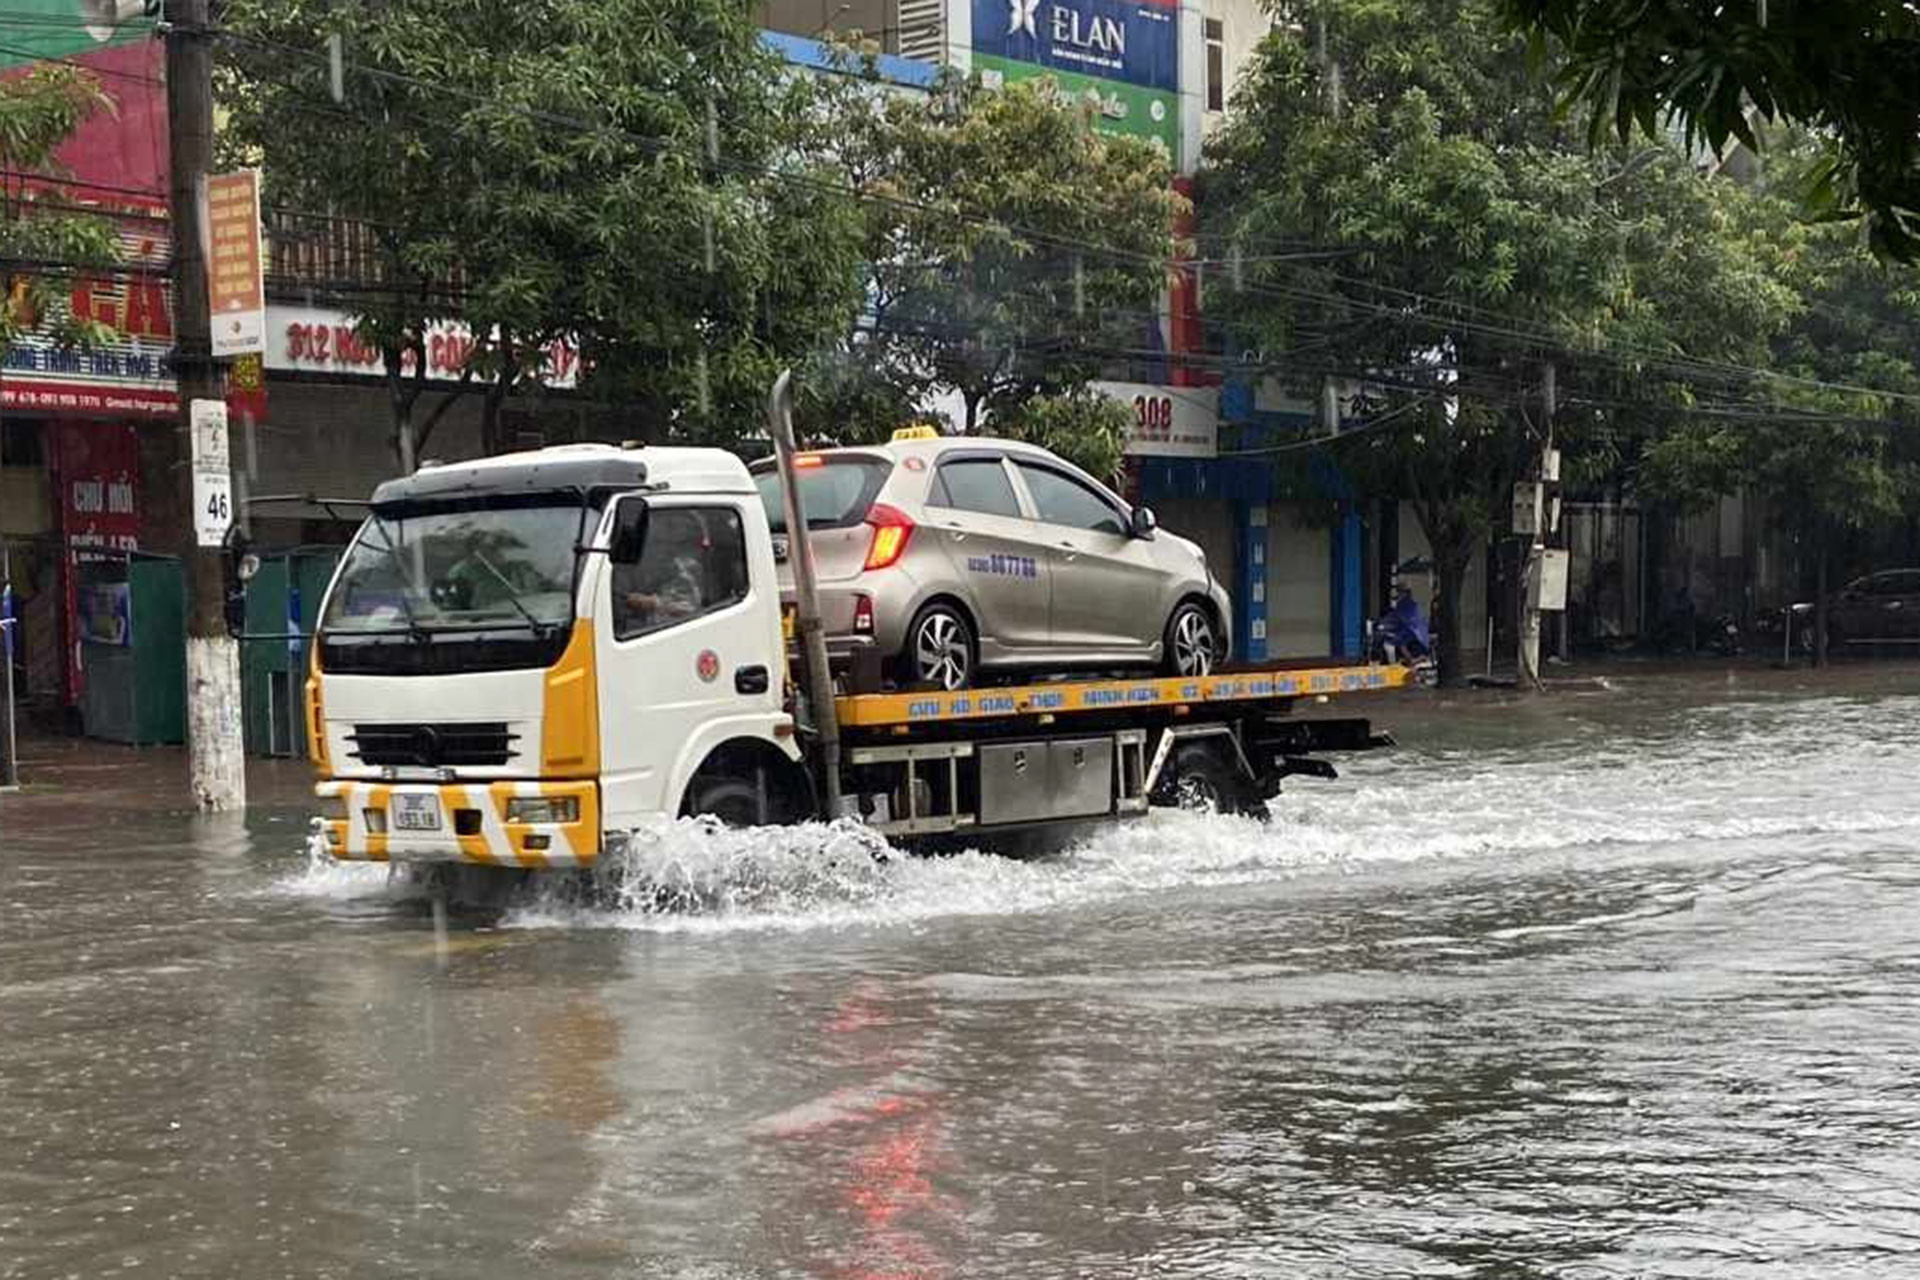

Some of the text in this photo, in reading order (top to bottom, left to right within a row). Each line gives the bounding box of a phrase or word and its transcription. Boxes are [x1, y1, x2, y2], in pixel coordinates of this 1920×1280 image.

[1052, 6, 1126, 54] ELAN
[287, 322, 330, 361] 312
[1135, 395, 1172, 429] 308
[208, 493, 228, 519] 46
